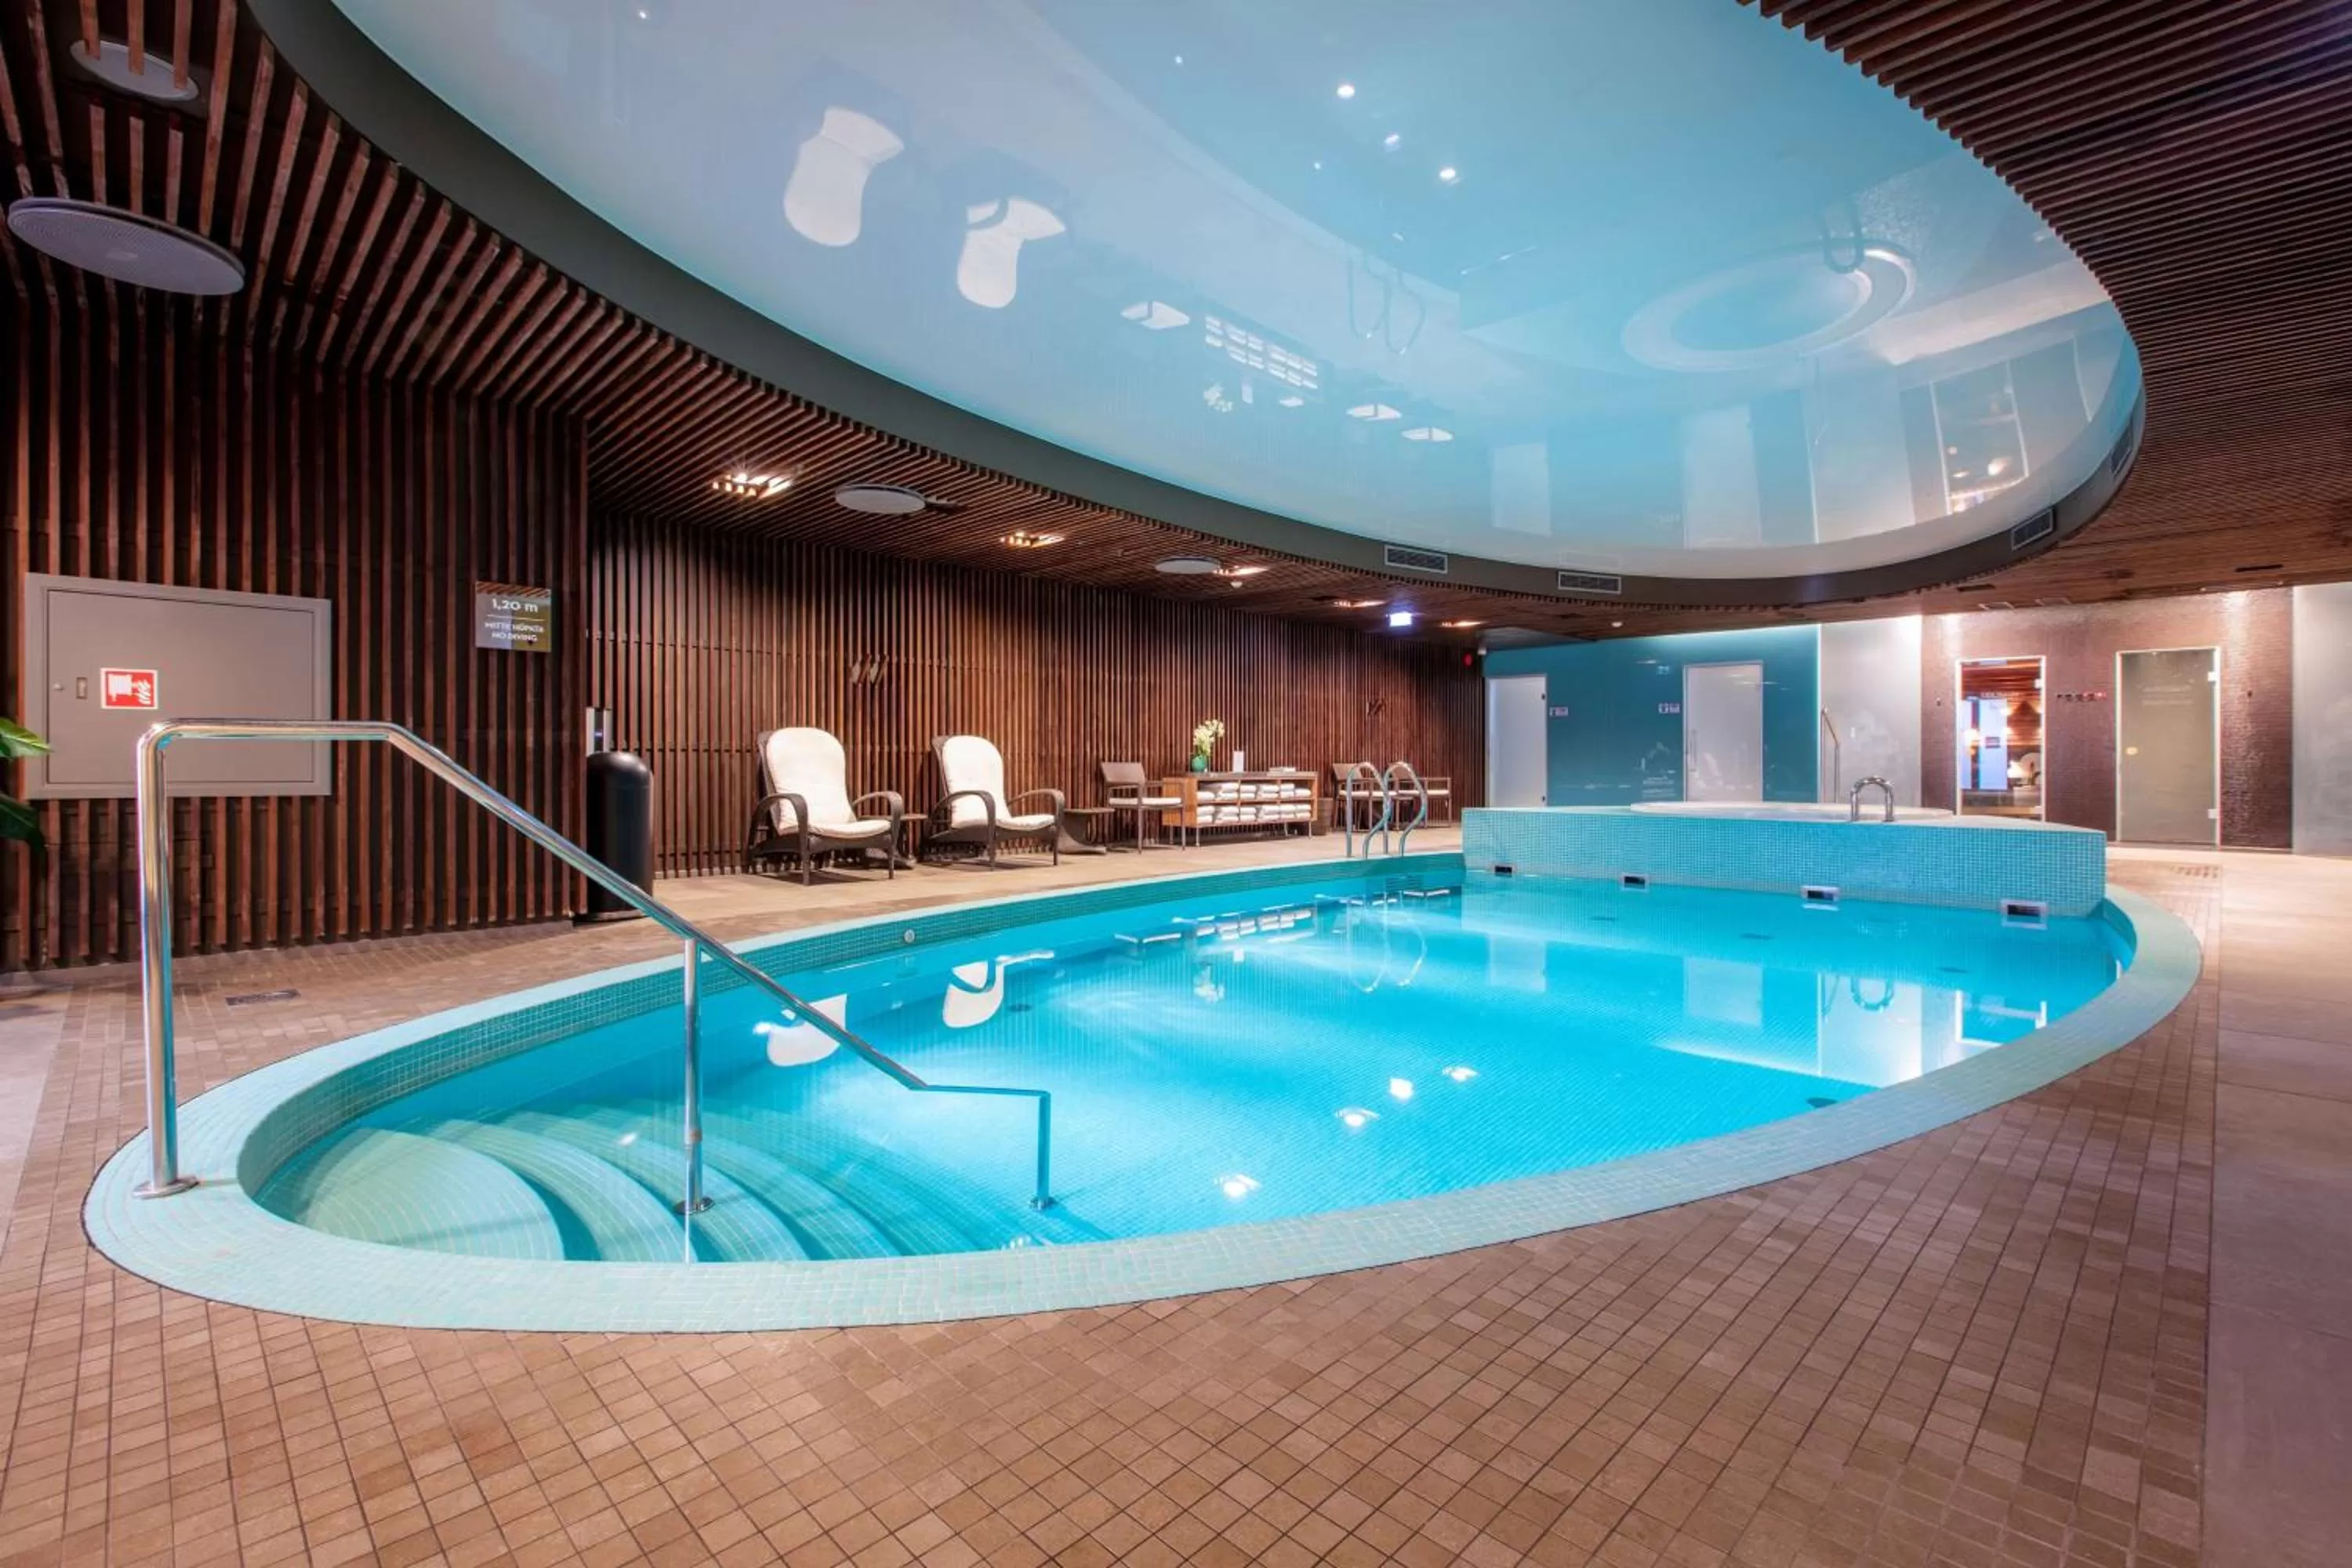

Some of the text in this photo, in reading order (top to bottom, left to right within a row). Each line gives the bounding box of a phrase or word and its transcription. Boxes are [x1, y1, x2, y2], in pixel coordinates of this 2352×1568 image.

[492, 598, 539, 612] 1,20 m
[508, 633, 538, 642] DIVING
